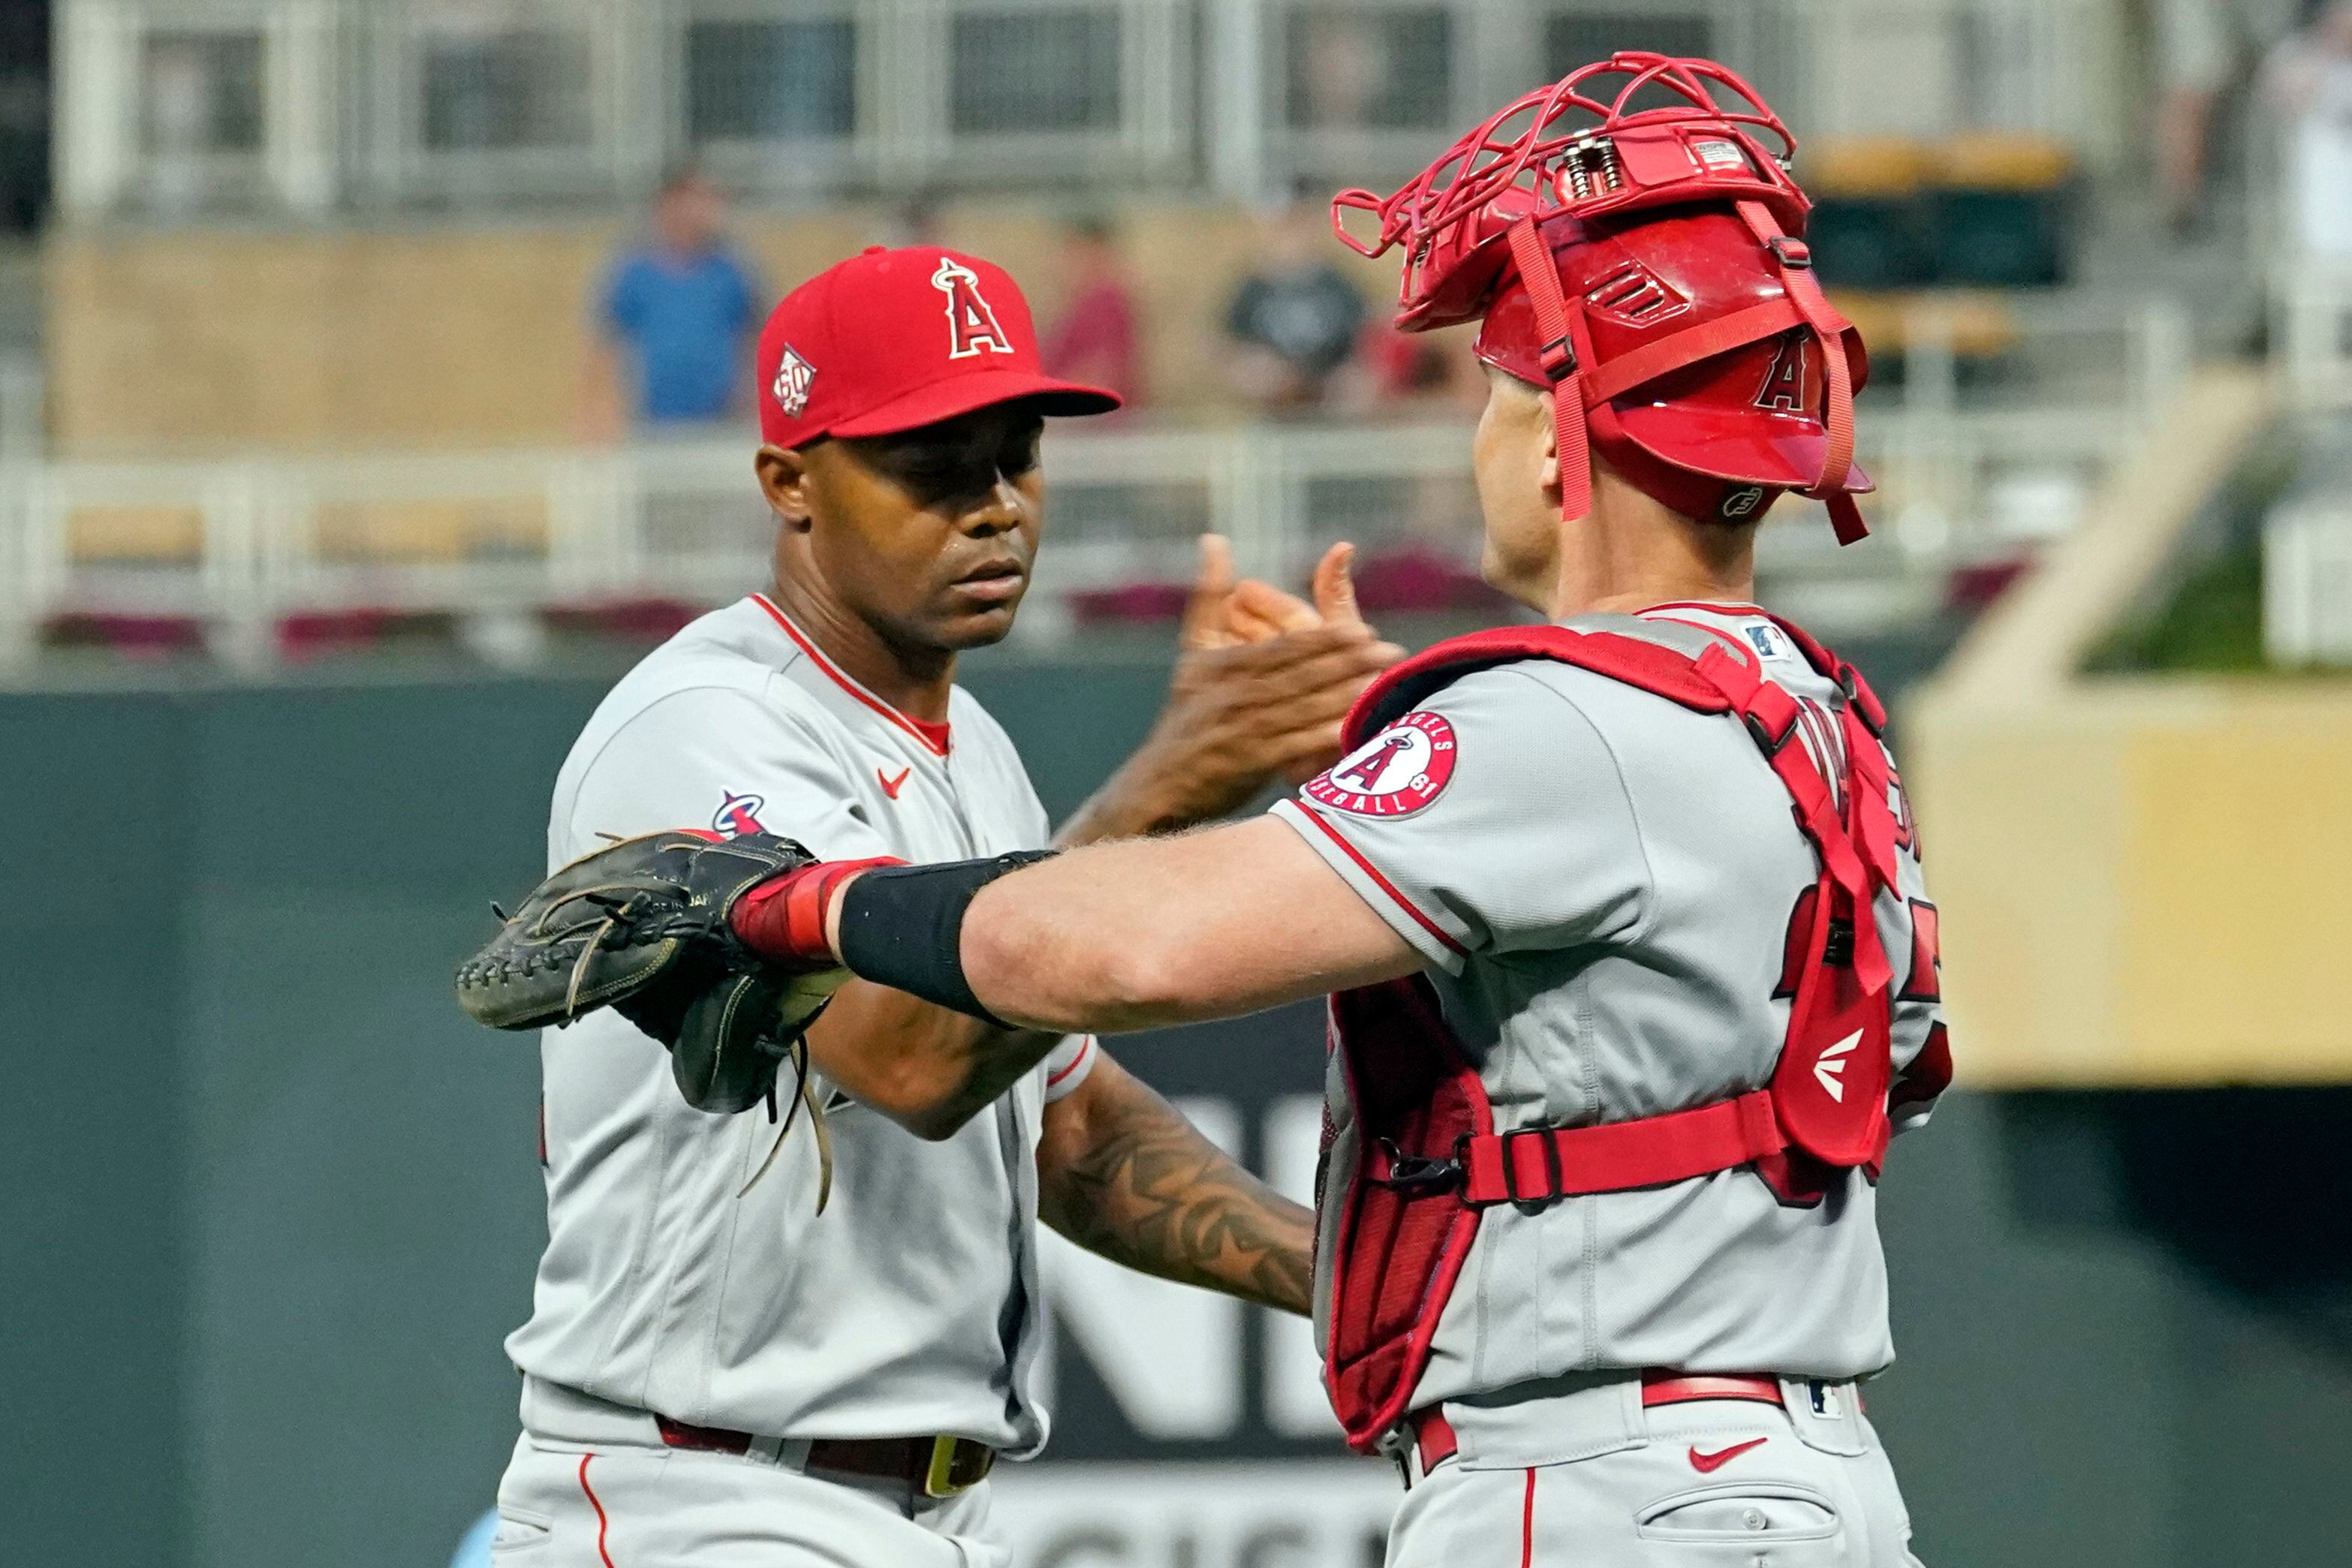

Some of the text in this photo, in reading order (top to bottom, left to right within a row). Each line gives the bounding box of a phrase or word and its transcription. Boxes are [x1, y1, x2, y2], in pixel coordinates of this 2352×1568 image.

[931, 257, 1014, 359] A
[1335, 730, 1414, 791] A
[1410, 772, 1438, 799] 61
[1309, 768, 1407, 813] SEBALL
